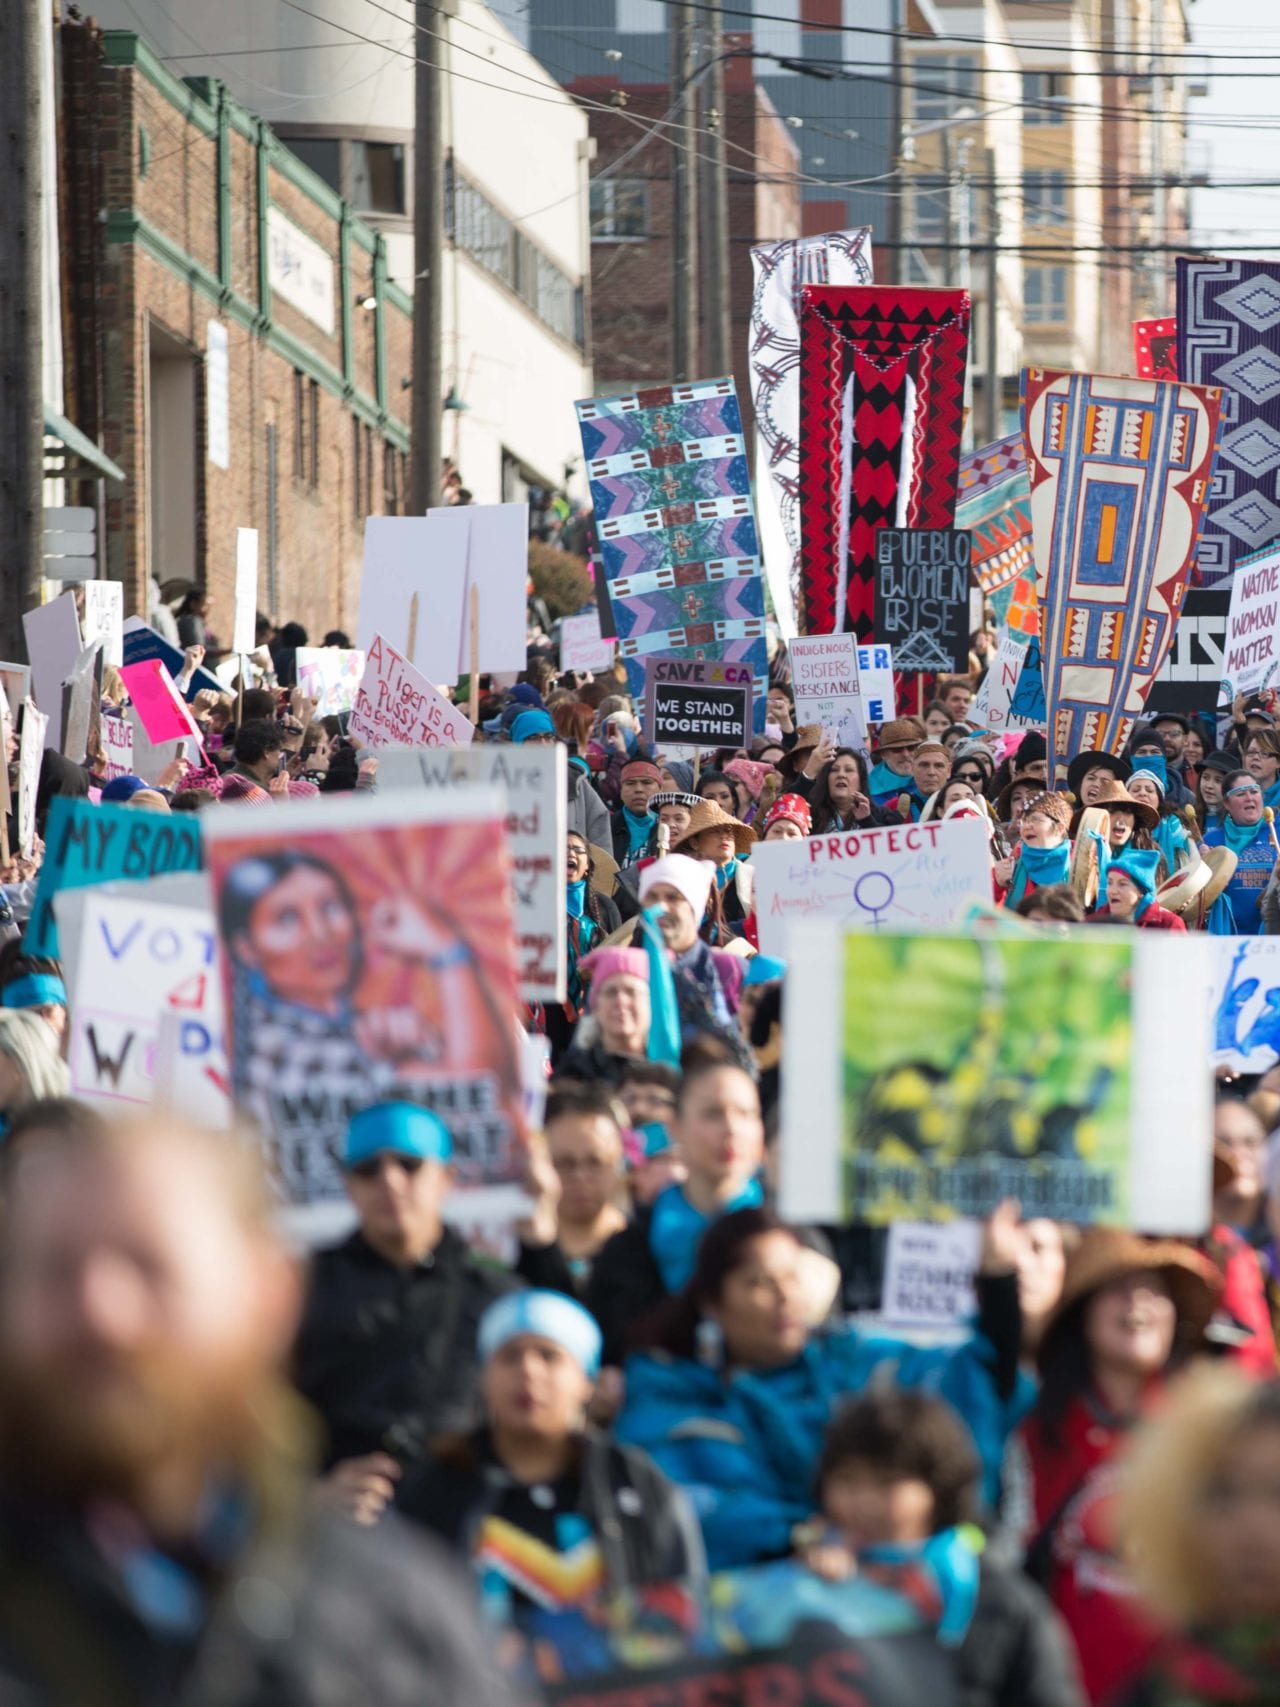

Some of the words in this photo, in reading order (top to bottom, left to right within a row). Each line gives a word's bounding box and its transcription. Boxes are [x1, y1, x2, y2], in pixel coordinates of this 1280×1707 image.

[879, 531, 969, 566] PUEBLO
[881, 565, 967, 602] WOMEN
[1241, 565, 1280, 602] NATIVE
[885, 599, 959, 636] RISE
[1232, 601, 1278, 640] WOMXN
[793, 643, 852, 656] INDIGENOUS
[1227, 634, 1273, 673] MATTER
[654, 663, 704, 682] SAVE
[710, 667, 751, 684] ACA
[796, 680, 859, 696] RESISTANCE
[801, 660, 850, 679] SISTERS
[428, 697, 442, 727] is
[443, 722, 457, 744] a
[656, 699, 679, 713] WE
[685, 701, 735, 716] STAND
[420, 722, 448, 747] TO
[656, 718, 743, 735] TOGETHER
[419, 752, 468, 789] We
[490, 751, 542, 789] Are
[56, 815, 118, 871] MY
[123, 818, 204, 876] BOD
[809, 825, 942, 863] PROTECT
